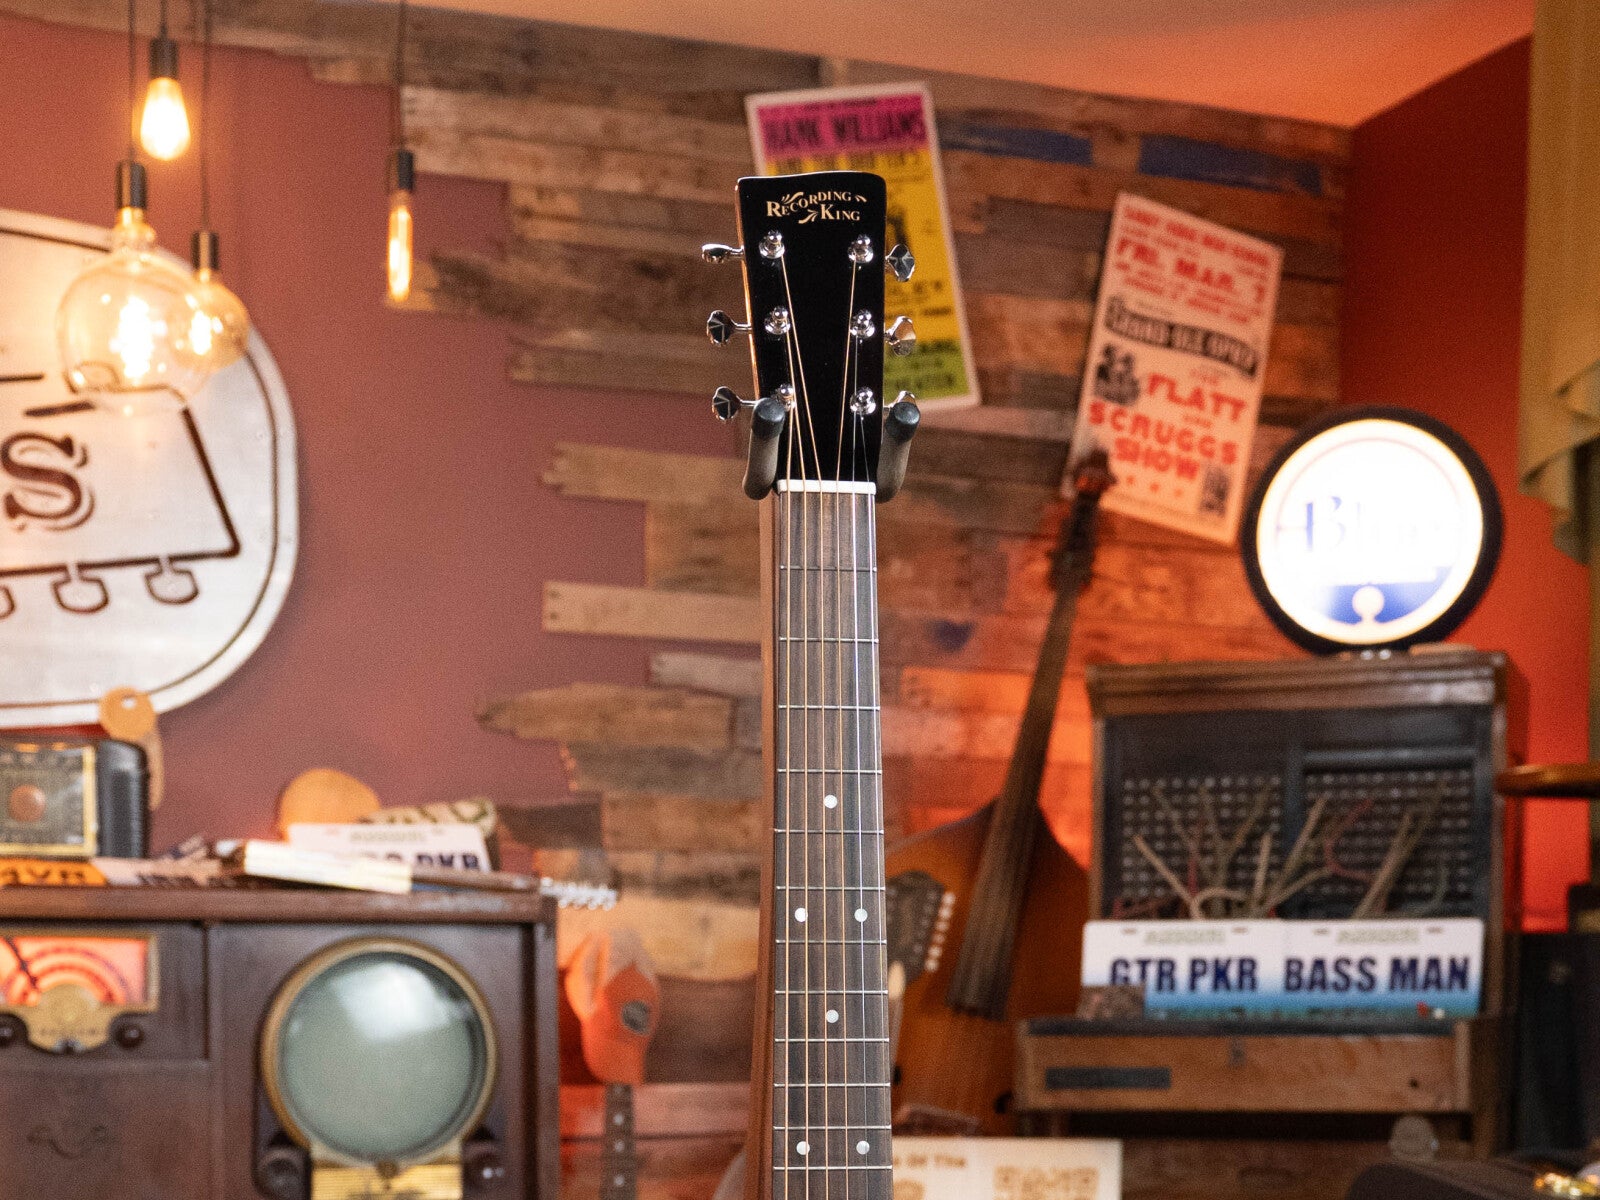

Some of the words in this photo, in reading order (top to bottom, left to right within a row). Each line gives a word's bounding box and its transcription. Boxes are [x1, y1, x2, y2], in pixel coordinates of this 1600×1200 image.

[766, 191, 852, 217] RECORDING
[820, 203, 861, 221] KING
[1147, 372, 1248, 423] FLATT
[1087, 401, 1239, 466] SCRUGGS
[1113, 437, 1201, 481] SHOW
[1109, 957, 1178, 992] GTR
[1189, 957, 1259, 992] PKR
[1284, 957, 1378, 992] BASS
[1388, 956, 1469, 992] MAN
